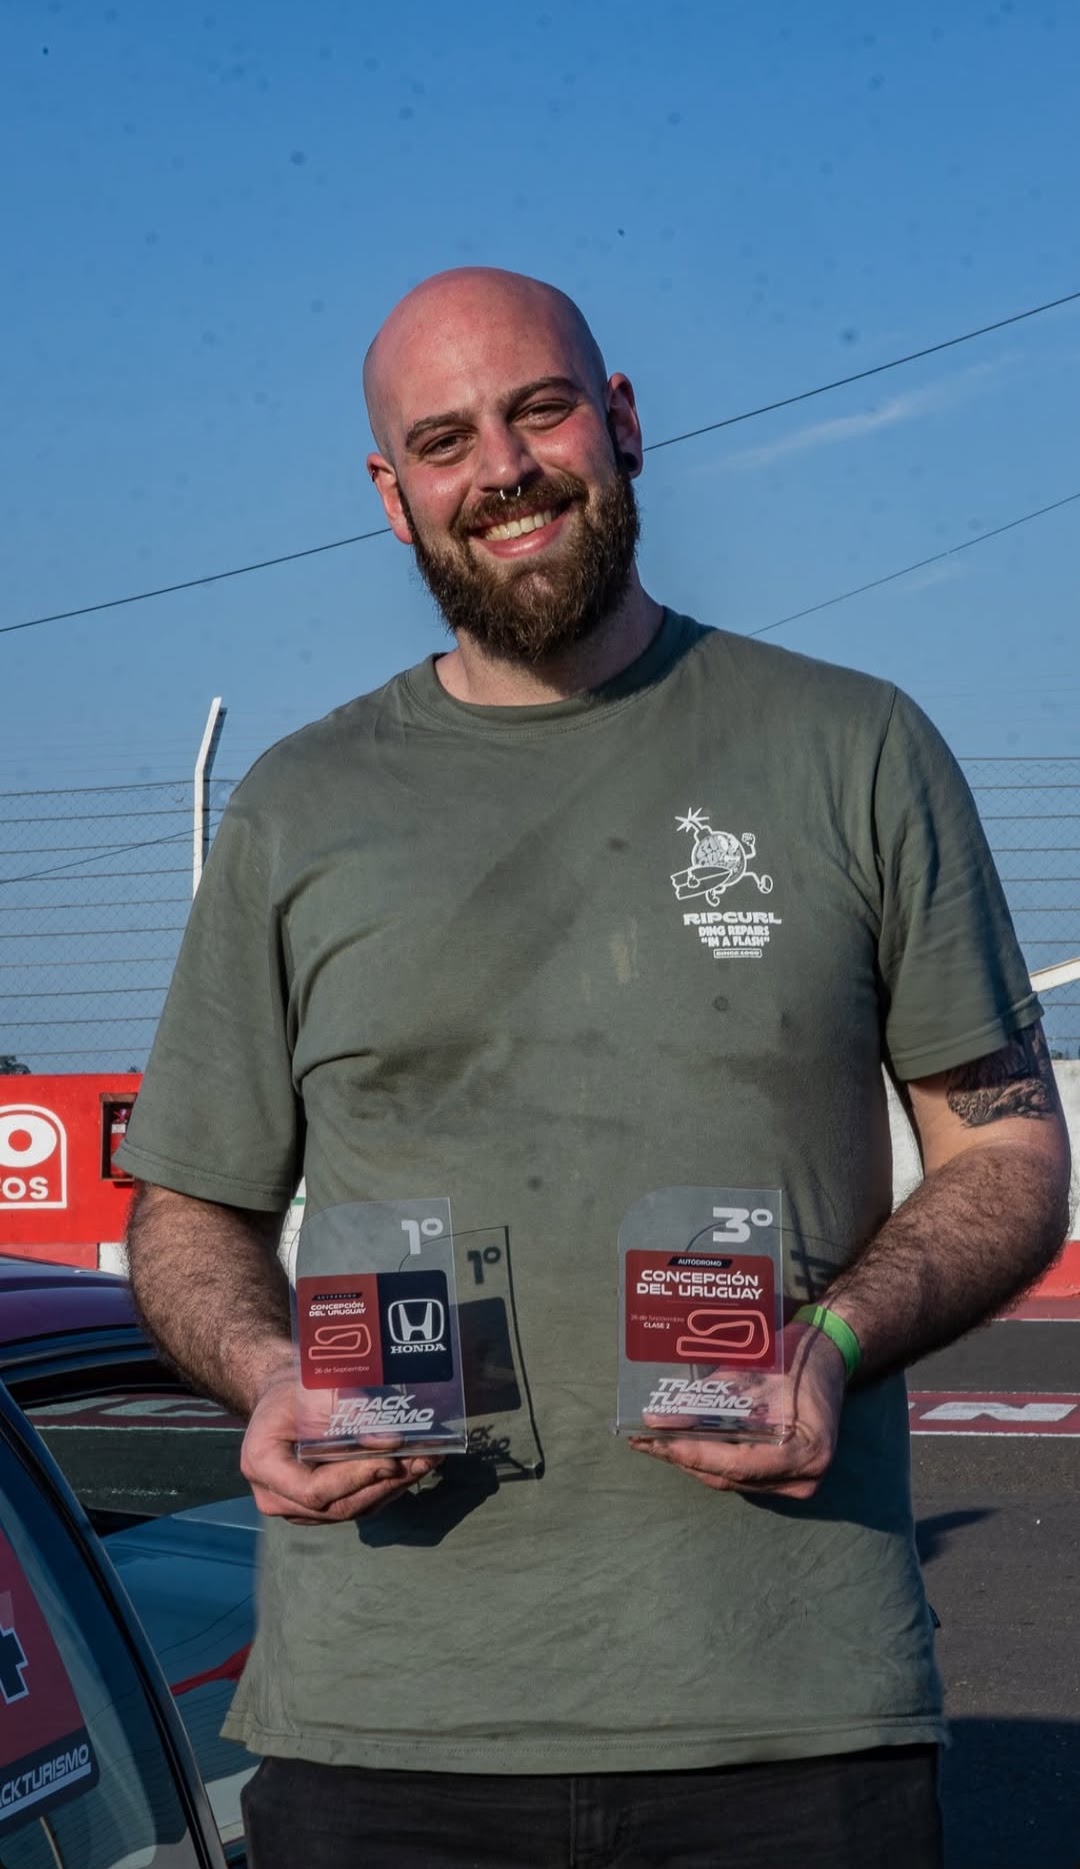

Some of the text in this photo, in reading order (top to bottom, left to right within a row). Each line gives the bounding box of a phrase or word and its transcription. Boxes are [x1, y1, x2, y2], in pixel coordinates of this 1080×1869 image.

[683, 911, 782, 926] RIPCURL
[698, 924, 770, 937] DING REPAIRS
[722, 936, 731, 947] A
[0, 1176, 49, 1200] OS
[641, 1269, 759, 1287] CONCEPCIÓN
[636, 1282, 763, 1300] DEL URUGUAY
[310, 1300, 365, 1311] CONCEPCIÓN
[327, 1308, 367, 1317] URUGUAY
[390, 1343, 447, 1354] HONDA
[658, 1378, 734, 1393] TRACK
[337, 1395, 415, 1412] TRACK
[649, 1392, 752, 1408] TURISMO
[330, 1408, 434, 1426] TURISMO
